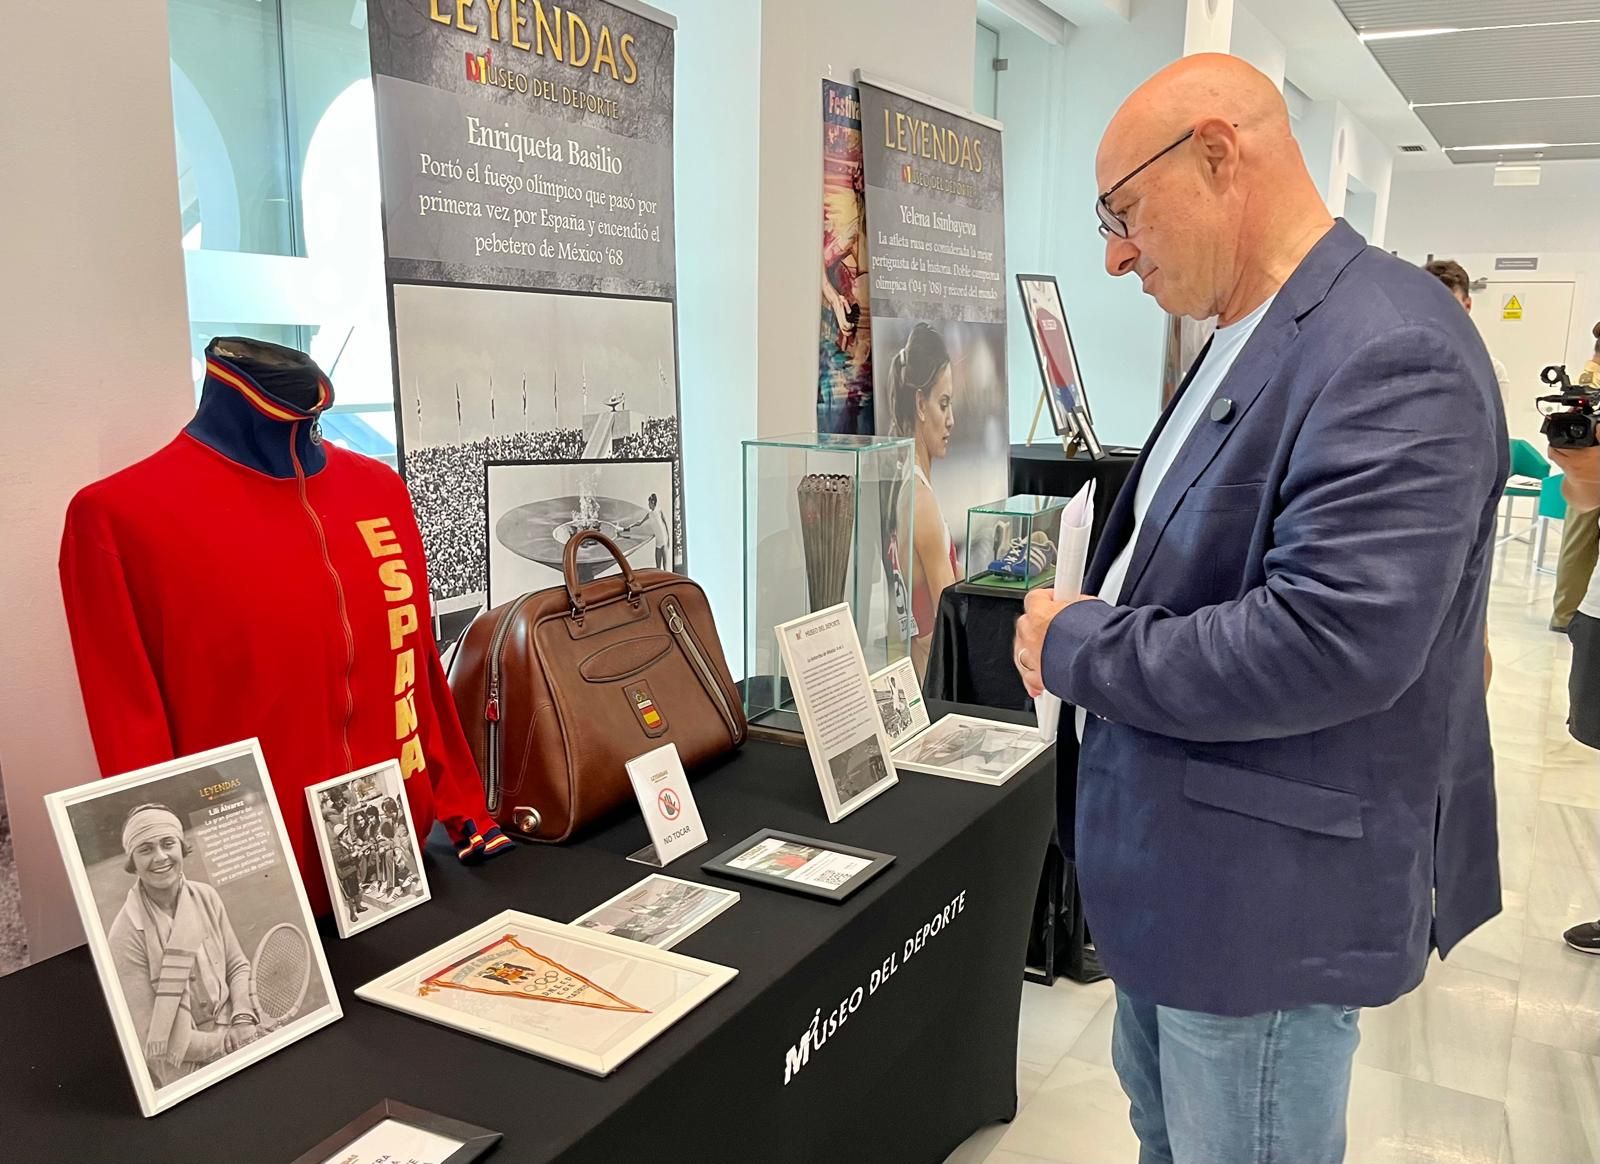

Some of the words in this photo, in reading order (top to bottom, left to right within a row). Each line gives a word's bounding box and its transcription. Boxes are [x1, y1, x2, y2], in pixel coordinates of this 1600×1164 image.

[533, 78, 559, 103] DEL
[562, 86, 620, 120] DEPORTE
[466, 115, 564, 164] Enriqueta
[568, 139, 622, 175] Basilio
[883, 108, 984, 173] LEYENDAS
[420, 152, 463, 180] Portó
[466, 162, 480, 183] el
[484, 165, 523, 195] fuego
[526, 173, 582, 203] olímpico
[585, 189, 606, 209] que
[609, 192, 636, 212] pasó
[638, 199, 657, 215] por
[419, 190, 482, 217] primera
[486, 203, 511, 222] vez
[513, 208, 537, 228] por
[540, 208, 585, 233] España
[587, 221, 595, 238] y
[598, 217, 647, 241] encendió
[650, 223, 661, 243] el
[899, 205, 931, 228] Yelena
[932, 211, 977, 239] Isinbayeva
[475, 232, 536, 257] pebetero
[539, 239, 555, 259] de
[558, 242, 603, 264] México
[878, 231, 888, 245] La
[888, 233, 909, 248] atleta
[925, 242, 933, 252] es
[910, 257, 919, 270] de
[356, 517, 426, 780] ESPAÑA
[199, 778, 241, 798] LEYENDAS
[663, 835, 673, 845] NO
[672, 825, 691, 840] TOCAR
[869, 952, 899, 996] DEL
[902, 889, 967, 964] DEPORTE
